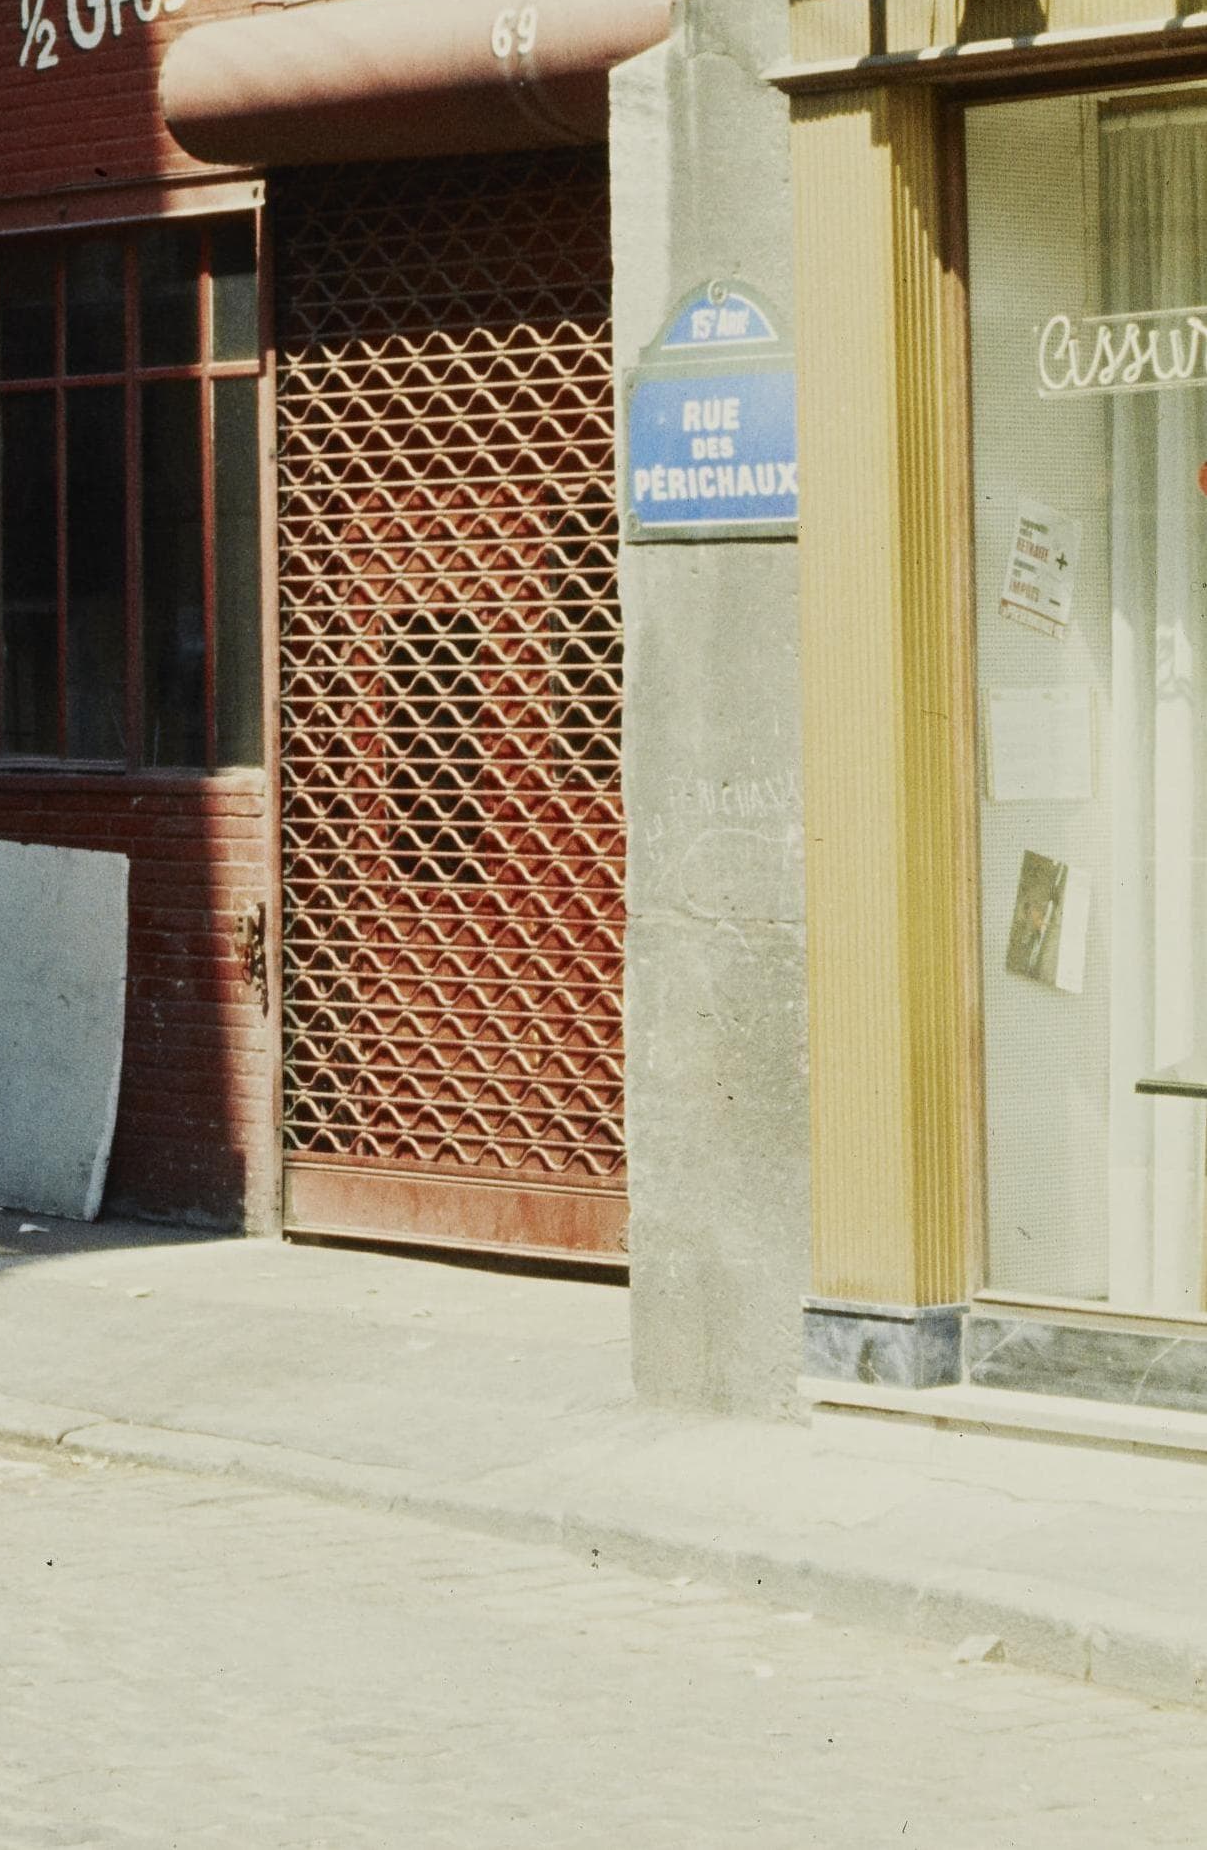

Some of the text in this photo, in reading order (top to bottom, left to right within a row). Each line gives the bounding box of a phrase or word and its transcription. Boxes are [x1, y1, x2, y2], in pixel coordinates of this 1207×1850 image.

[491, 7, 538, 58] 69
[682, 398, 741, 432] RUE
[692, 436, 734, 460] DES
[634, 462, 799, 501] PÉRICHAUX
